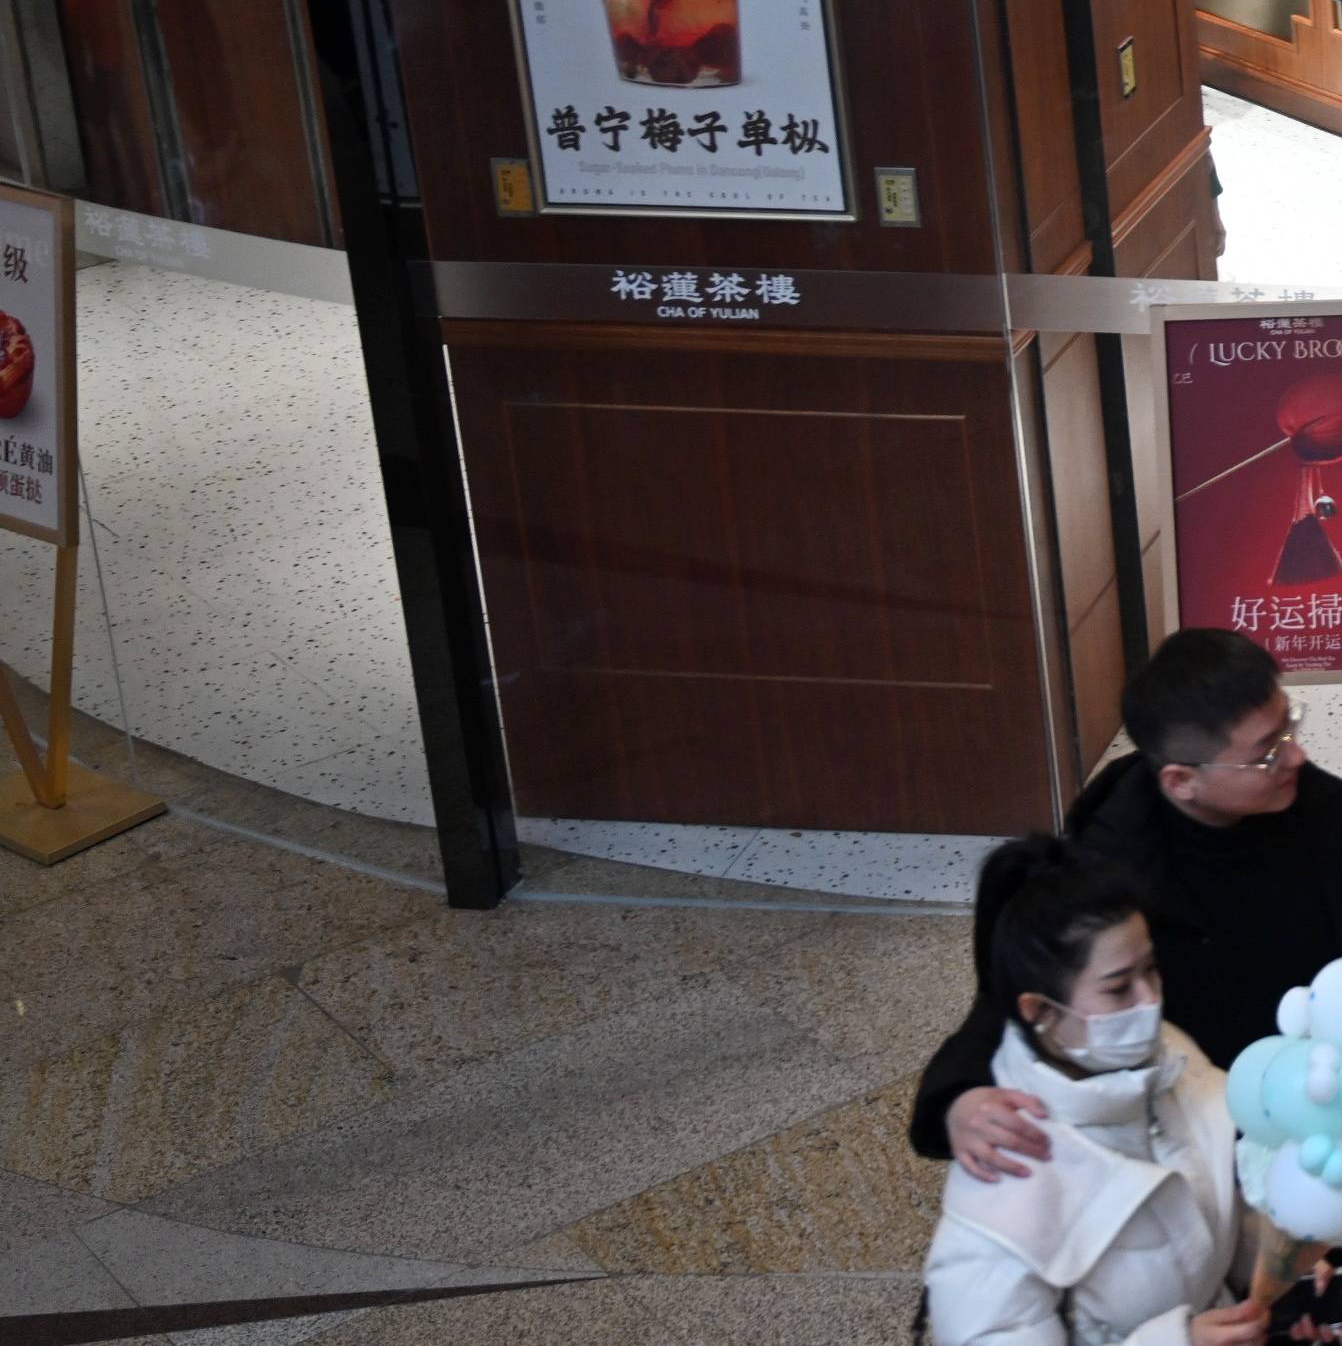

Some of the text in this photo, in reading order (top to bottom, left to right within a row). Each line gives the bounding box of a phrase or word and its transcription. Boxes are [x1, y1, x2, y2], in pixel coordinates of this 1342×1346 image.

[610, 270, 800, 306] 裕蓮茶樓
[656, 306, 760, 320] CHA OF YULIAN
[1209, 340, 1289, 366] LUCKY
[1275, 634, 1341, 652] 新年开运
